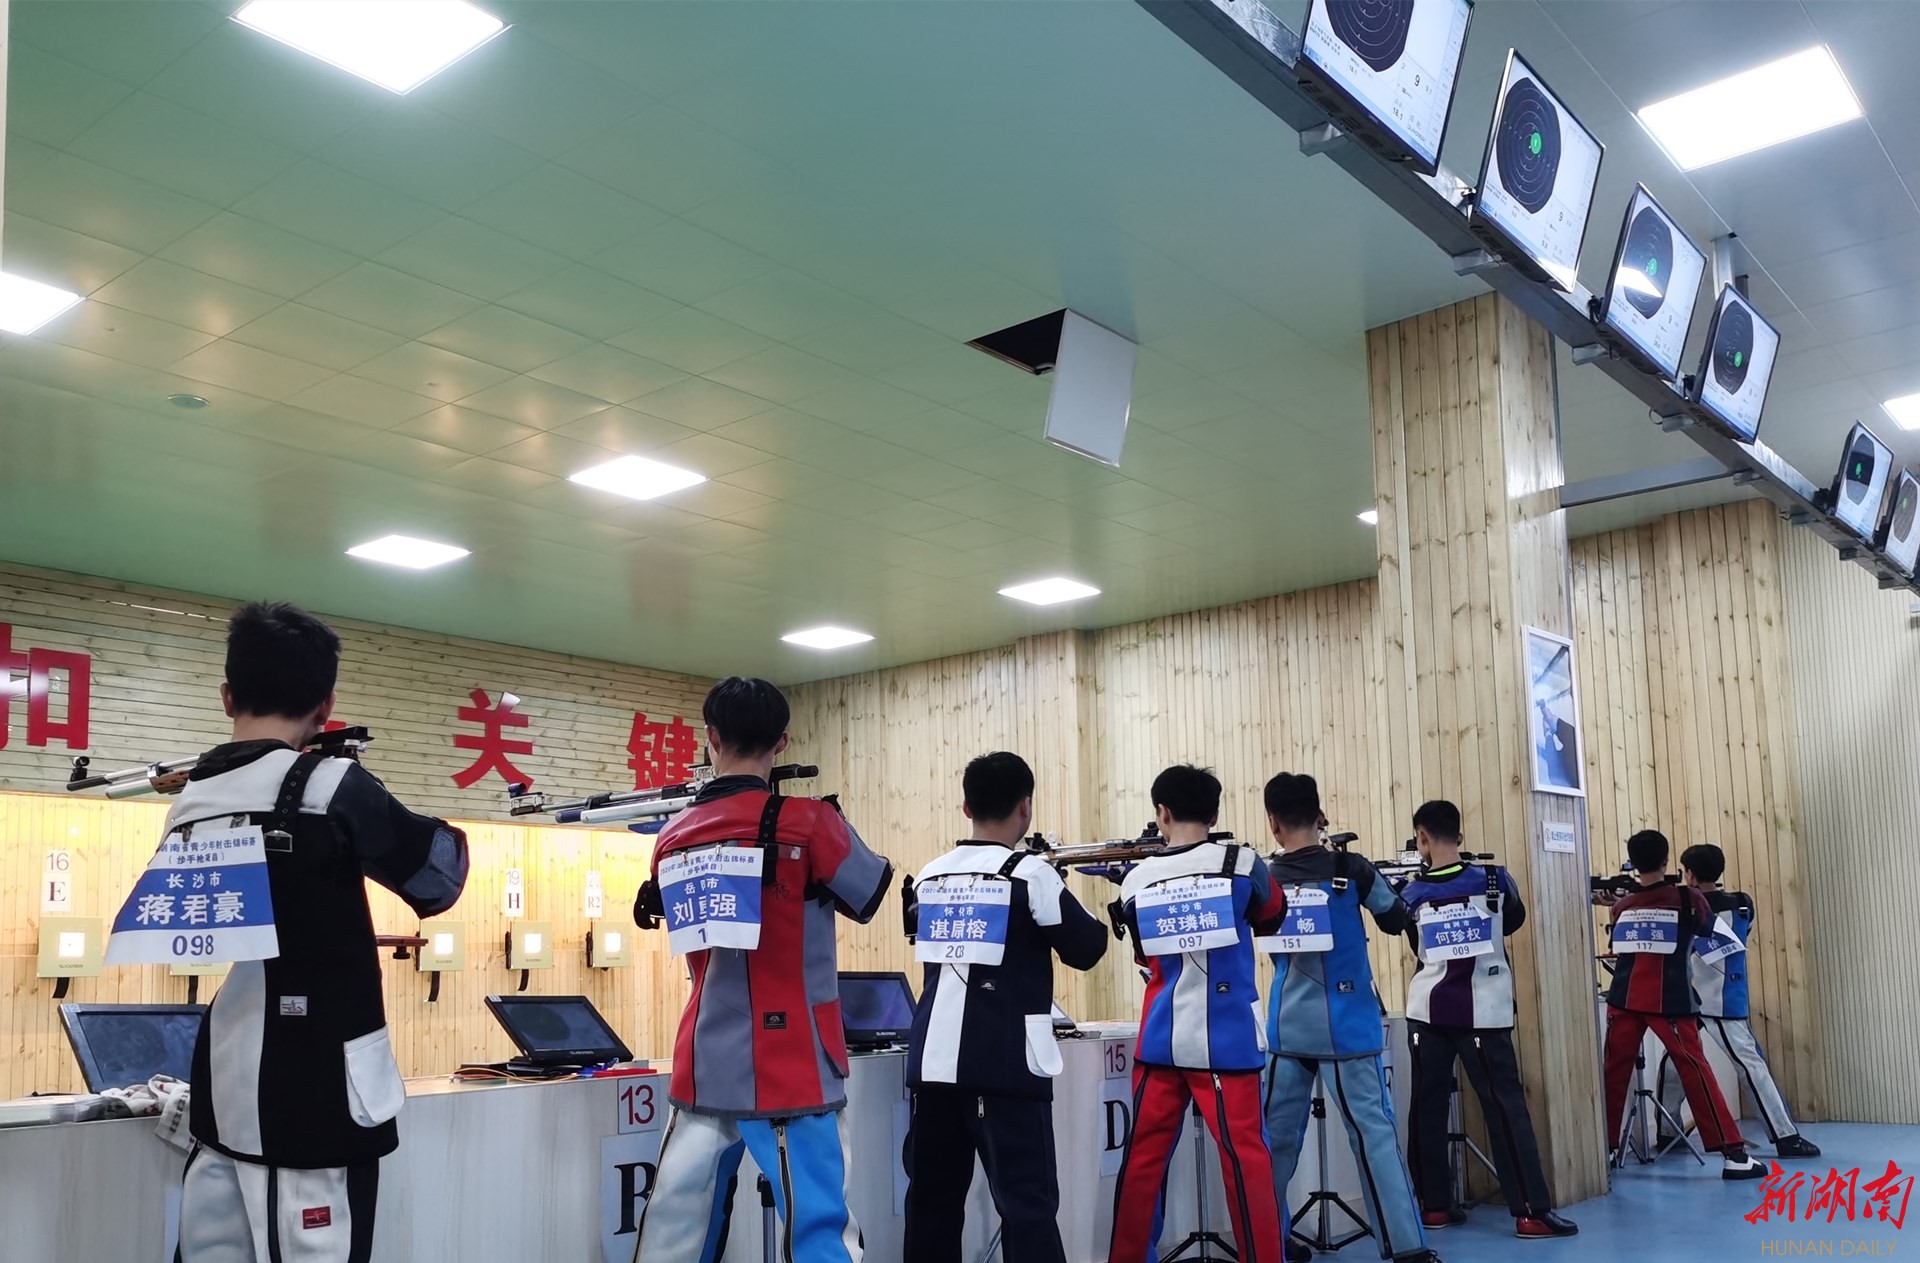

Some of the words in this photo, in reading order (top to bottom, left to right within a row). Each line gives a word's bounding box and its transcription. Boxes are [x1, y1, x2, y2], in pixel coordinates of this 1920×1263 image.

[1415, 74, 1420, 87] 9
[47, 852, 69, 871] 16
[166, 871, 222, 889] 长沙市
[506, 870, 520, 885] 19
[48, 881, 66, 902] E
[136, 890, 244, 926] 蒋君豪
[508, 892, 521, 909] H
[588, 896, 600, 908] R2
[1168, 902, 1202, 914] 长沙市
[944, 906, 974, 917] 怀化市
[1179, 935, 1203, 949] 097
[1282, 939, 1301, 949] 151
[1436, 928, 1481, 944] 何珍权
[172, 934, 214, 956] 098
[1453, 945, 1470, 956] 009
[1107, 1044, 1126, 1073] 15
[621, 1084, 655, 1125] 13
[1103, 1100, 1131, 1151] D
